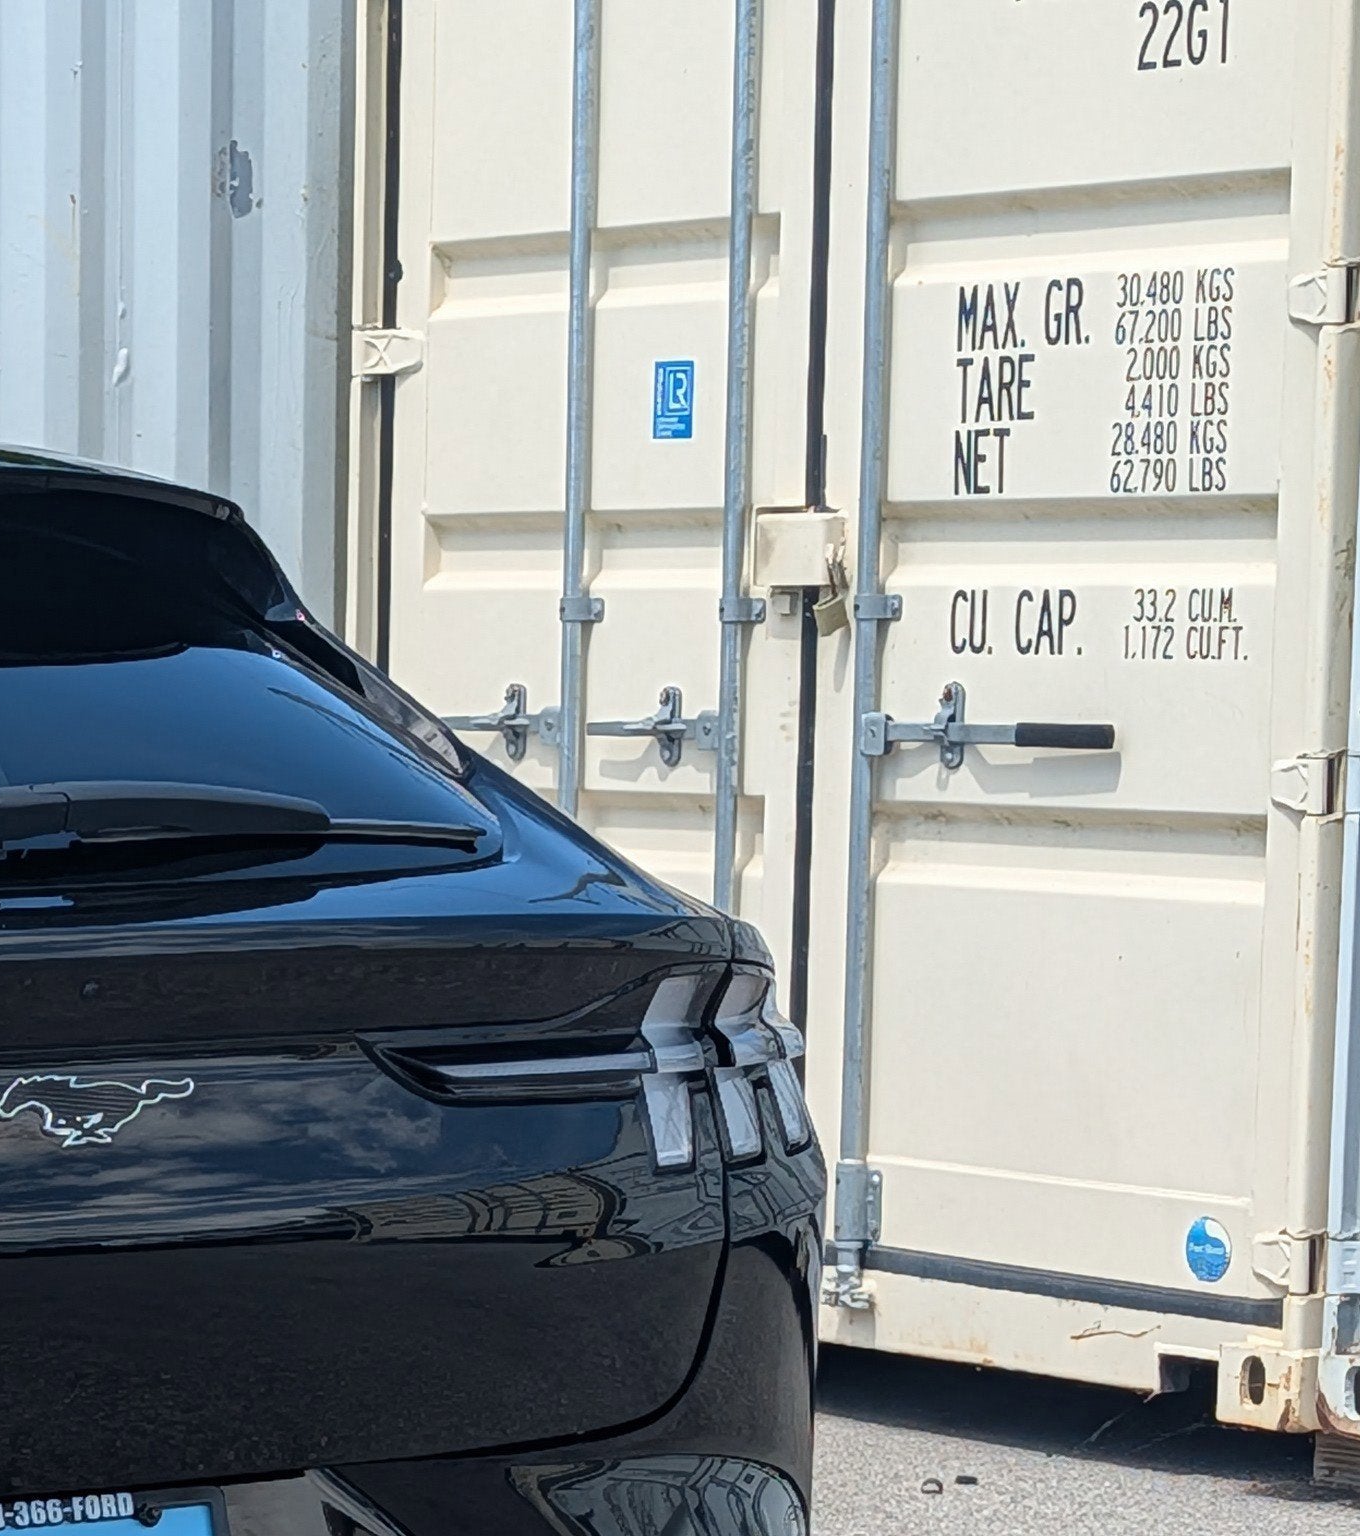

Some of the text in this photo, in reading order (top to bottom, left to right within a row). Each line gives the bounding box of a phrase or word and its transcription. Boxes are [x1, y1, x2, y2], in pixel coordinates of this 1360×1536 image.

[1138, 0, 1229, 70] 22G1
[957, 281, 1026, 351] MAX.
[1045, 277, 1090, 346] GR.
[1195, 267, 1235, 304] KGS
[1194, 305, 1232, 342] LBS
[956, 353, 1036, 424] TARE
[1191, 343, 1231, 380] KGS
[1191, 381, 1229, 417] LBS
[954, 428, 1011, 496] NET
[1189, 418, 1228, 455] KGS
[1188, 456, 1227, 492] LBS
[950, 589, 992, 655] CU.
[1015, 589, 1082, 655] CAP.
[1133, 588, 1176, 623] 33.2
